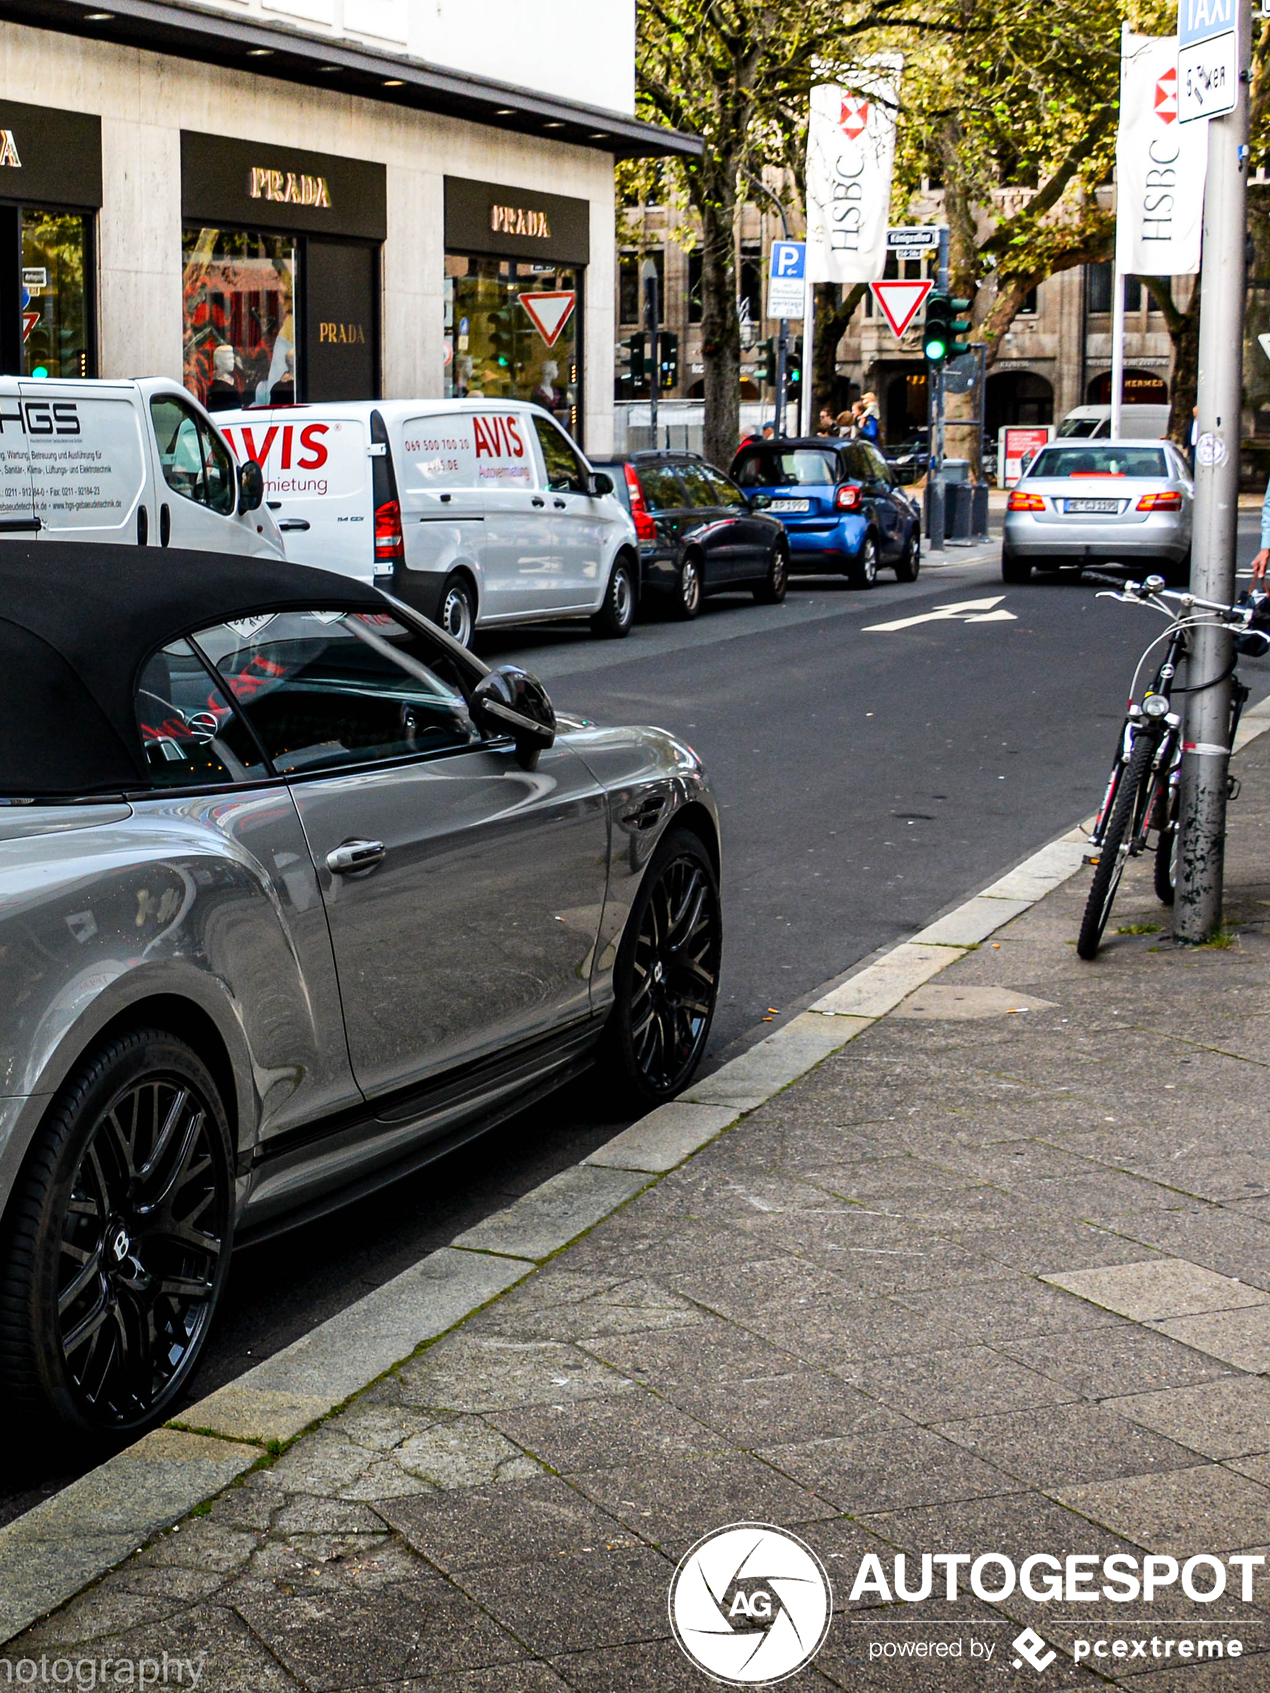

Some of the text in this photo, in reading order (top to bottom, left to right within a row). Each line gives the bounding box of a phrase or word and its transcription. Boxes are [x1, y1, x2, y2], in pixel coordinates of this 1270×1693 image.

[1197, 65, 1225, 91] Txen
[250, 167, 332, 208] PRADA
[1141, 139, 1180, 241] HSBC
[831, 155, 865, 251] HSBC
[492, 205, 550, 238] PRADA
[778, 246, 799, 276] P
[320, 322, 365, 343] PRADA
[405, 439, 470, 451] 069 500 700 20
[473, 416, 524, 458] AVIS
[5, 487, 17, 497] 0211
[263, 477, 328, 495] mietung
[113, 1231, 129, 1261] B
